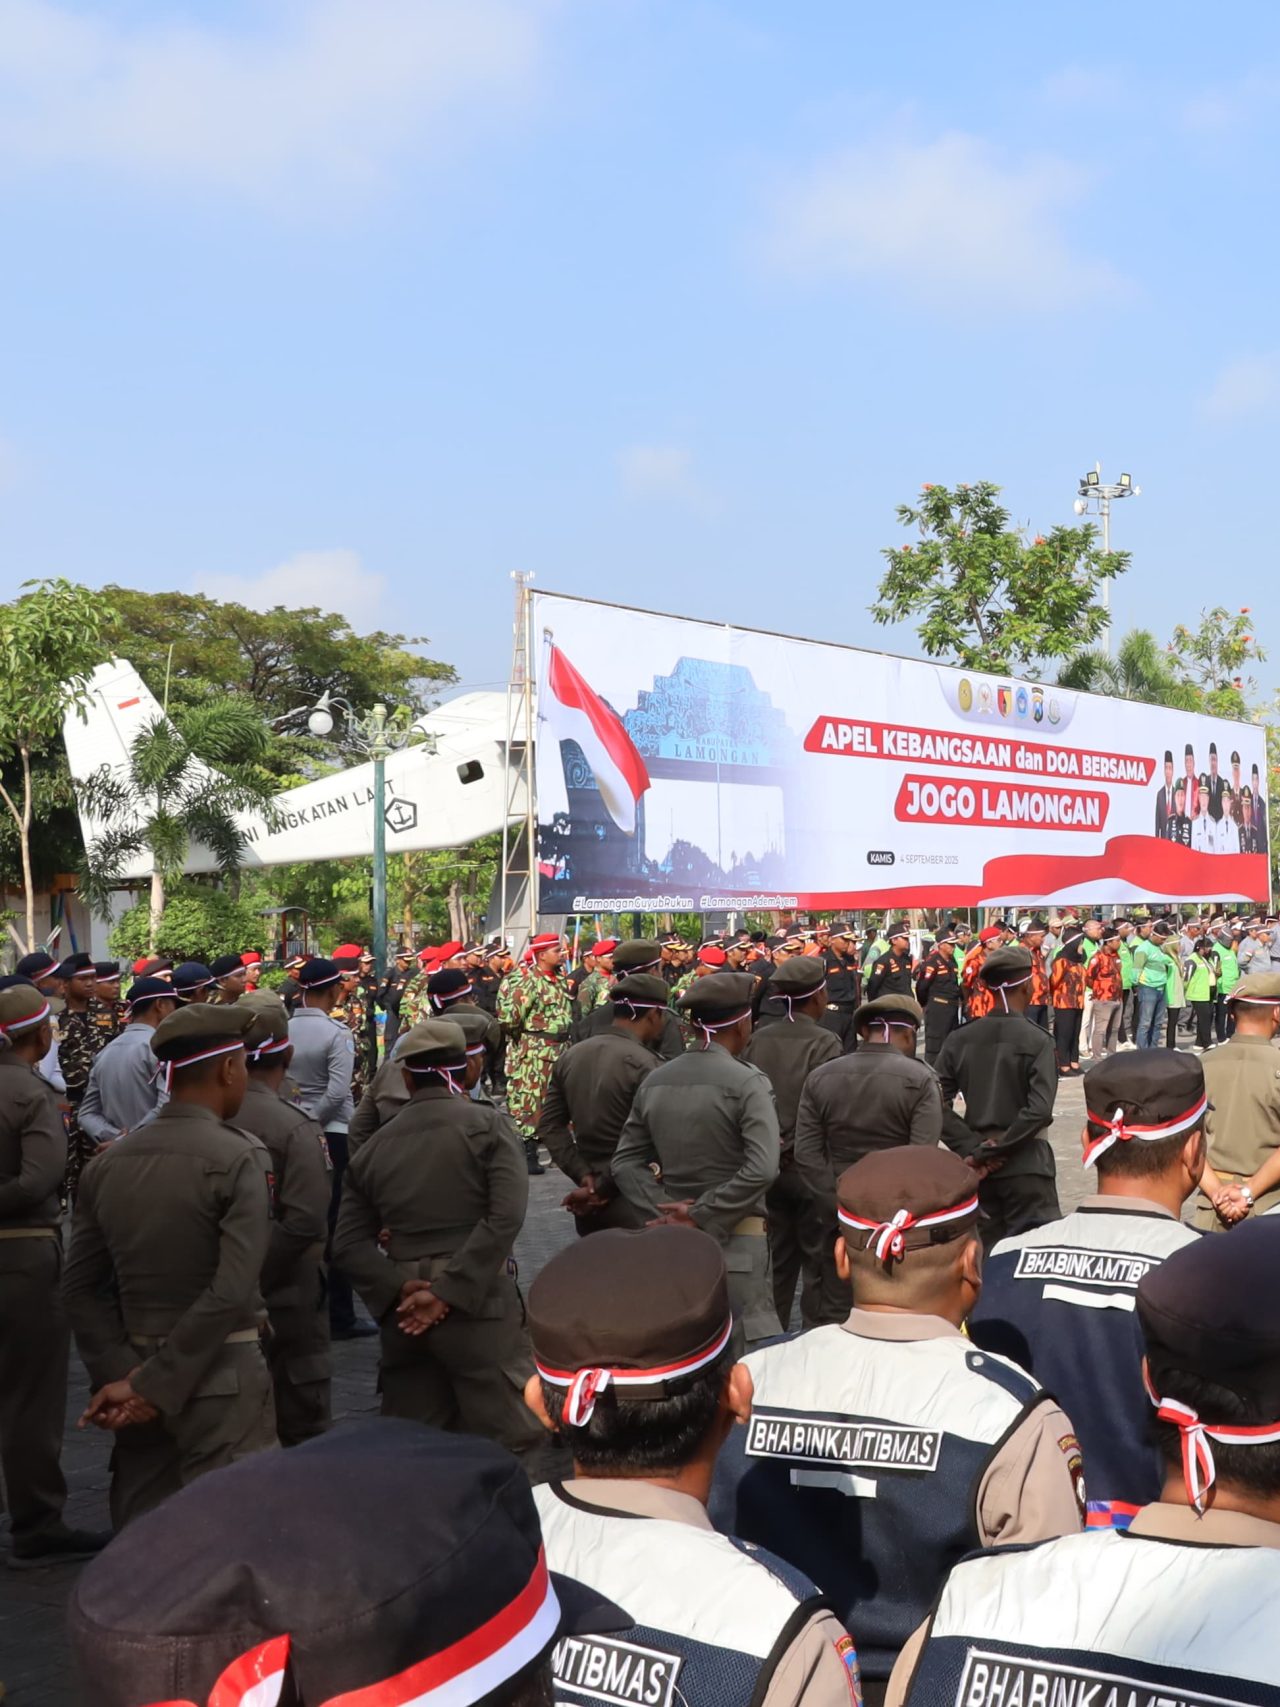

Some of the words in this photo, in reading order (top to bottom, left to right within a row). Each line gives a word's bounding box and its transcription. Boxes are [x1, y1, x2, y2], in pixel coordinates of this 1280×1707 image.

[675, 744, 759, 764] LAMONGAN
[821, 722, 878, 754] APEL
[882, 729, 1011, 768] KEBANGSAAN
[1015, 749, 1043, 771] dan
[1046, 751, 1080, 775] DOA
[1082, 756, 1147, 782] BERSAMA
[267, 796, 349, 837] ANGKATAN
[353, 779, 395, 806] LAT
[906, 782, 975, 818] JOGO
[982, 787, 1100, 826] LAMONGAN
[870, 853, 892, 864] KAMIS
[905, 854, 944, 864] SEPTEMBER
[944, 855, 959, 865] 2025
